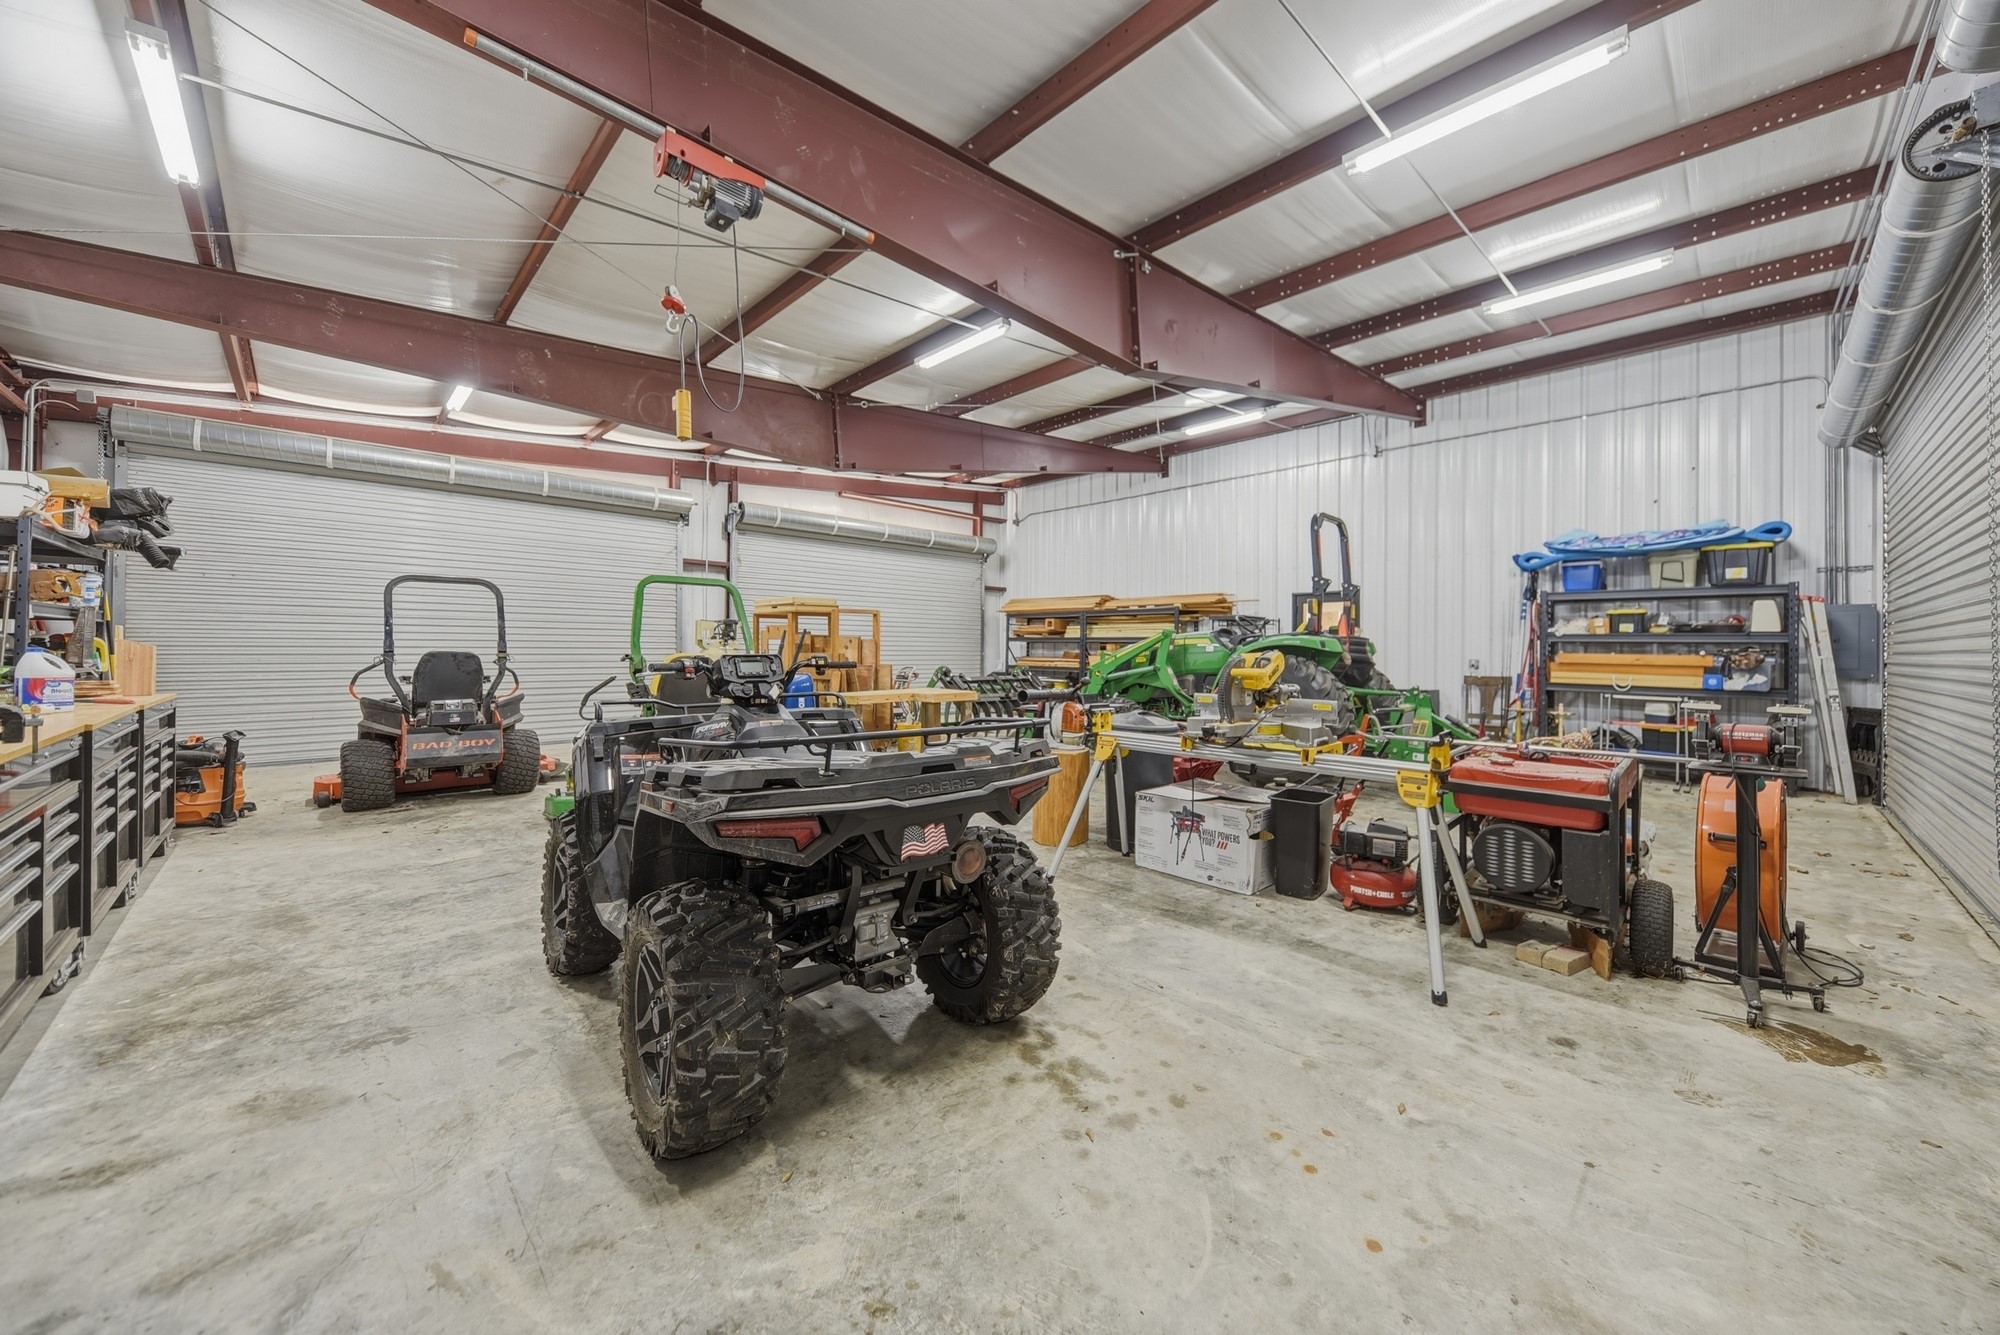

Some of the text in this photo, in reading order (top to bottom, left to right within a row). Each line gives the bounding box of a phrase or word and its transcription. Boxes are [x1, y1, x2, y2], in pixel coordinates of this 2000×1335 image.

[412, 738, 497, 750] BAD BOY
[905, 777, 976, 797] POLARIS
[1201, 828, 1241, 844] WHAT POWERS
[1202, 837, 1216, 847] YOU?
